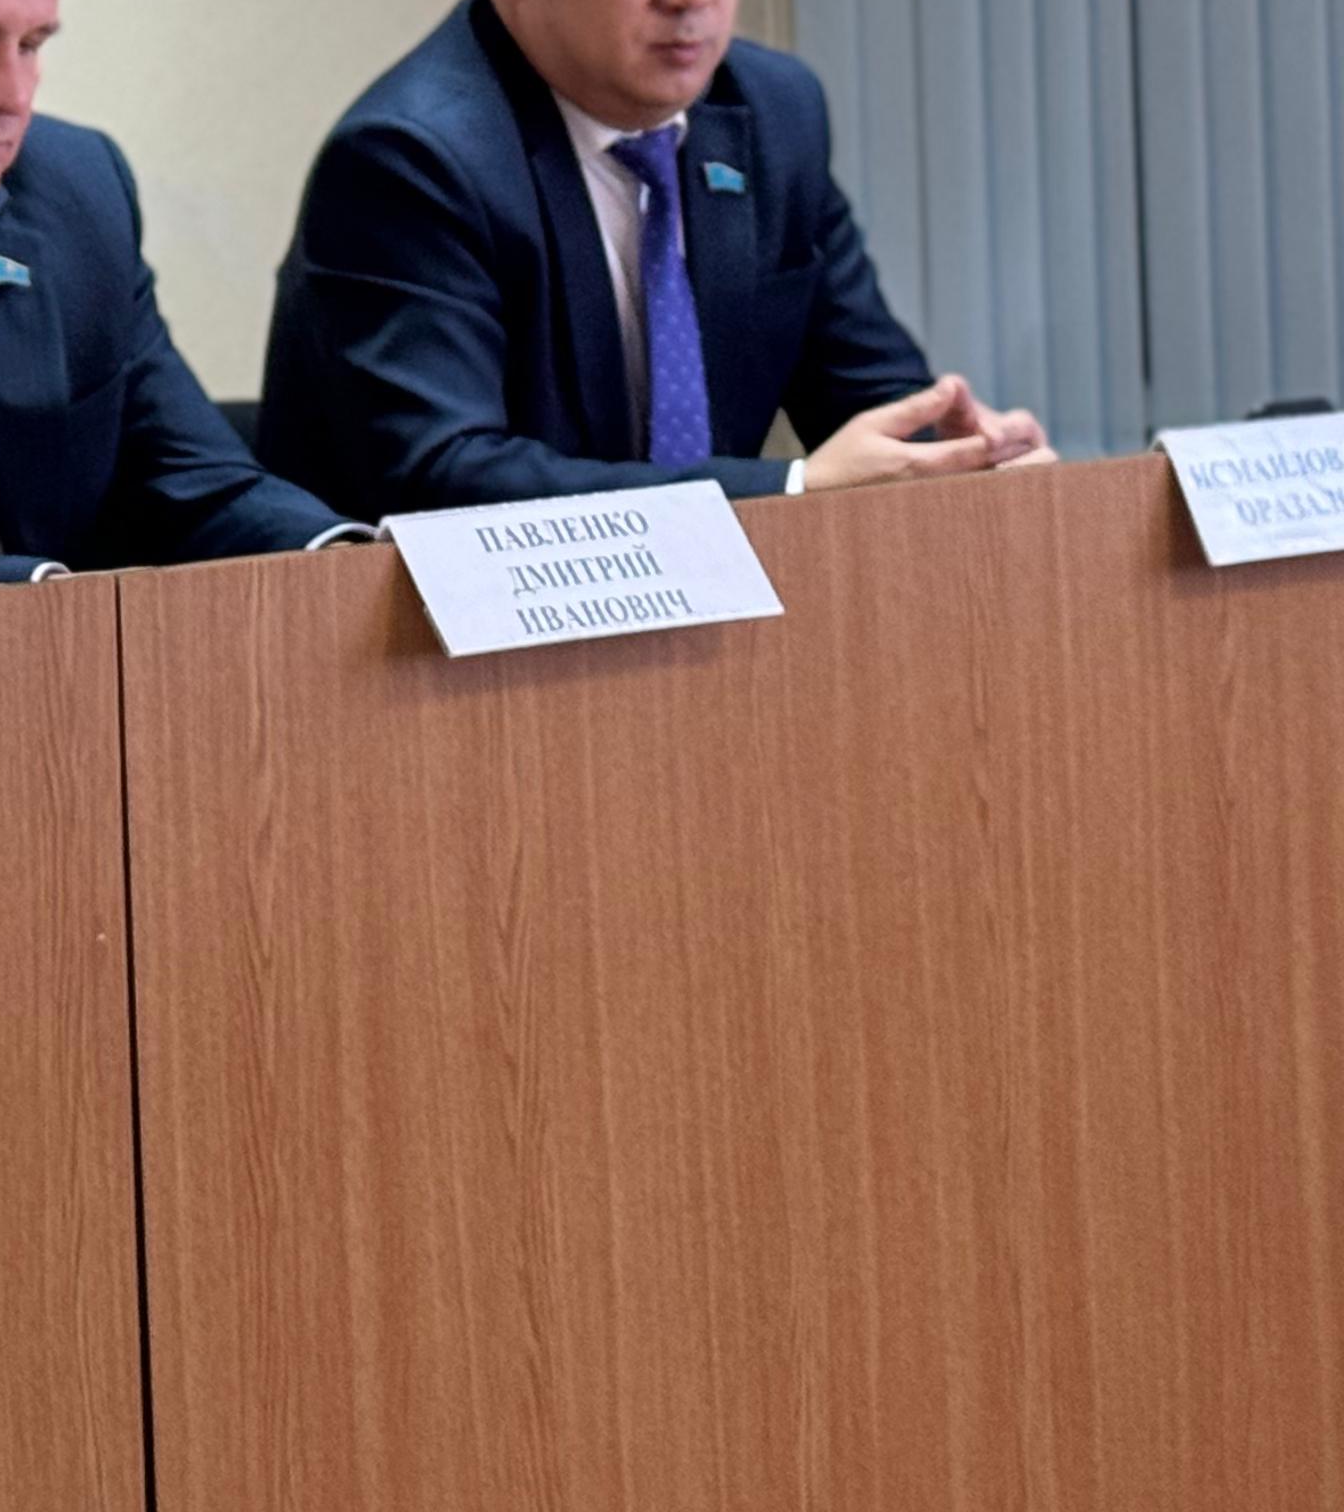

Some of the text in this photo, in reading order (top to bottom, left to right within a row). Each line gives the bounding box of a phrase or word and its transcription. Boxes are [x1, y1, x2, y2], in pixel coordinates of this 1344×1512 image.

[474, 509, 650, 553] ПАВЛЕНКО
[506, 543, 664, 599] ДМИТРИЙ
[515, 588, 694, 636] ИВАНОВИЧ
